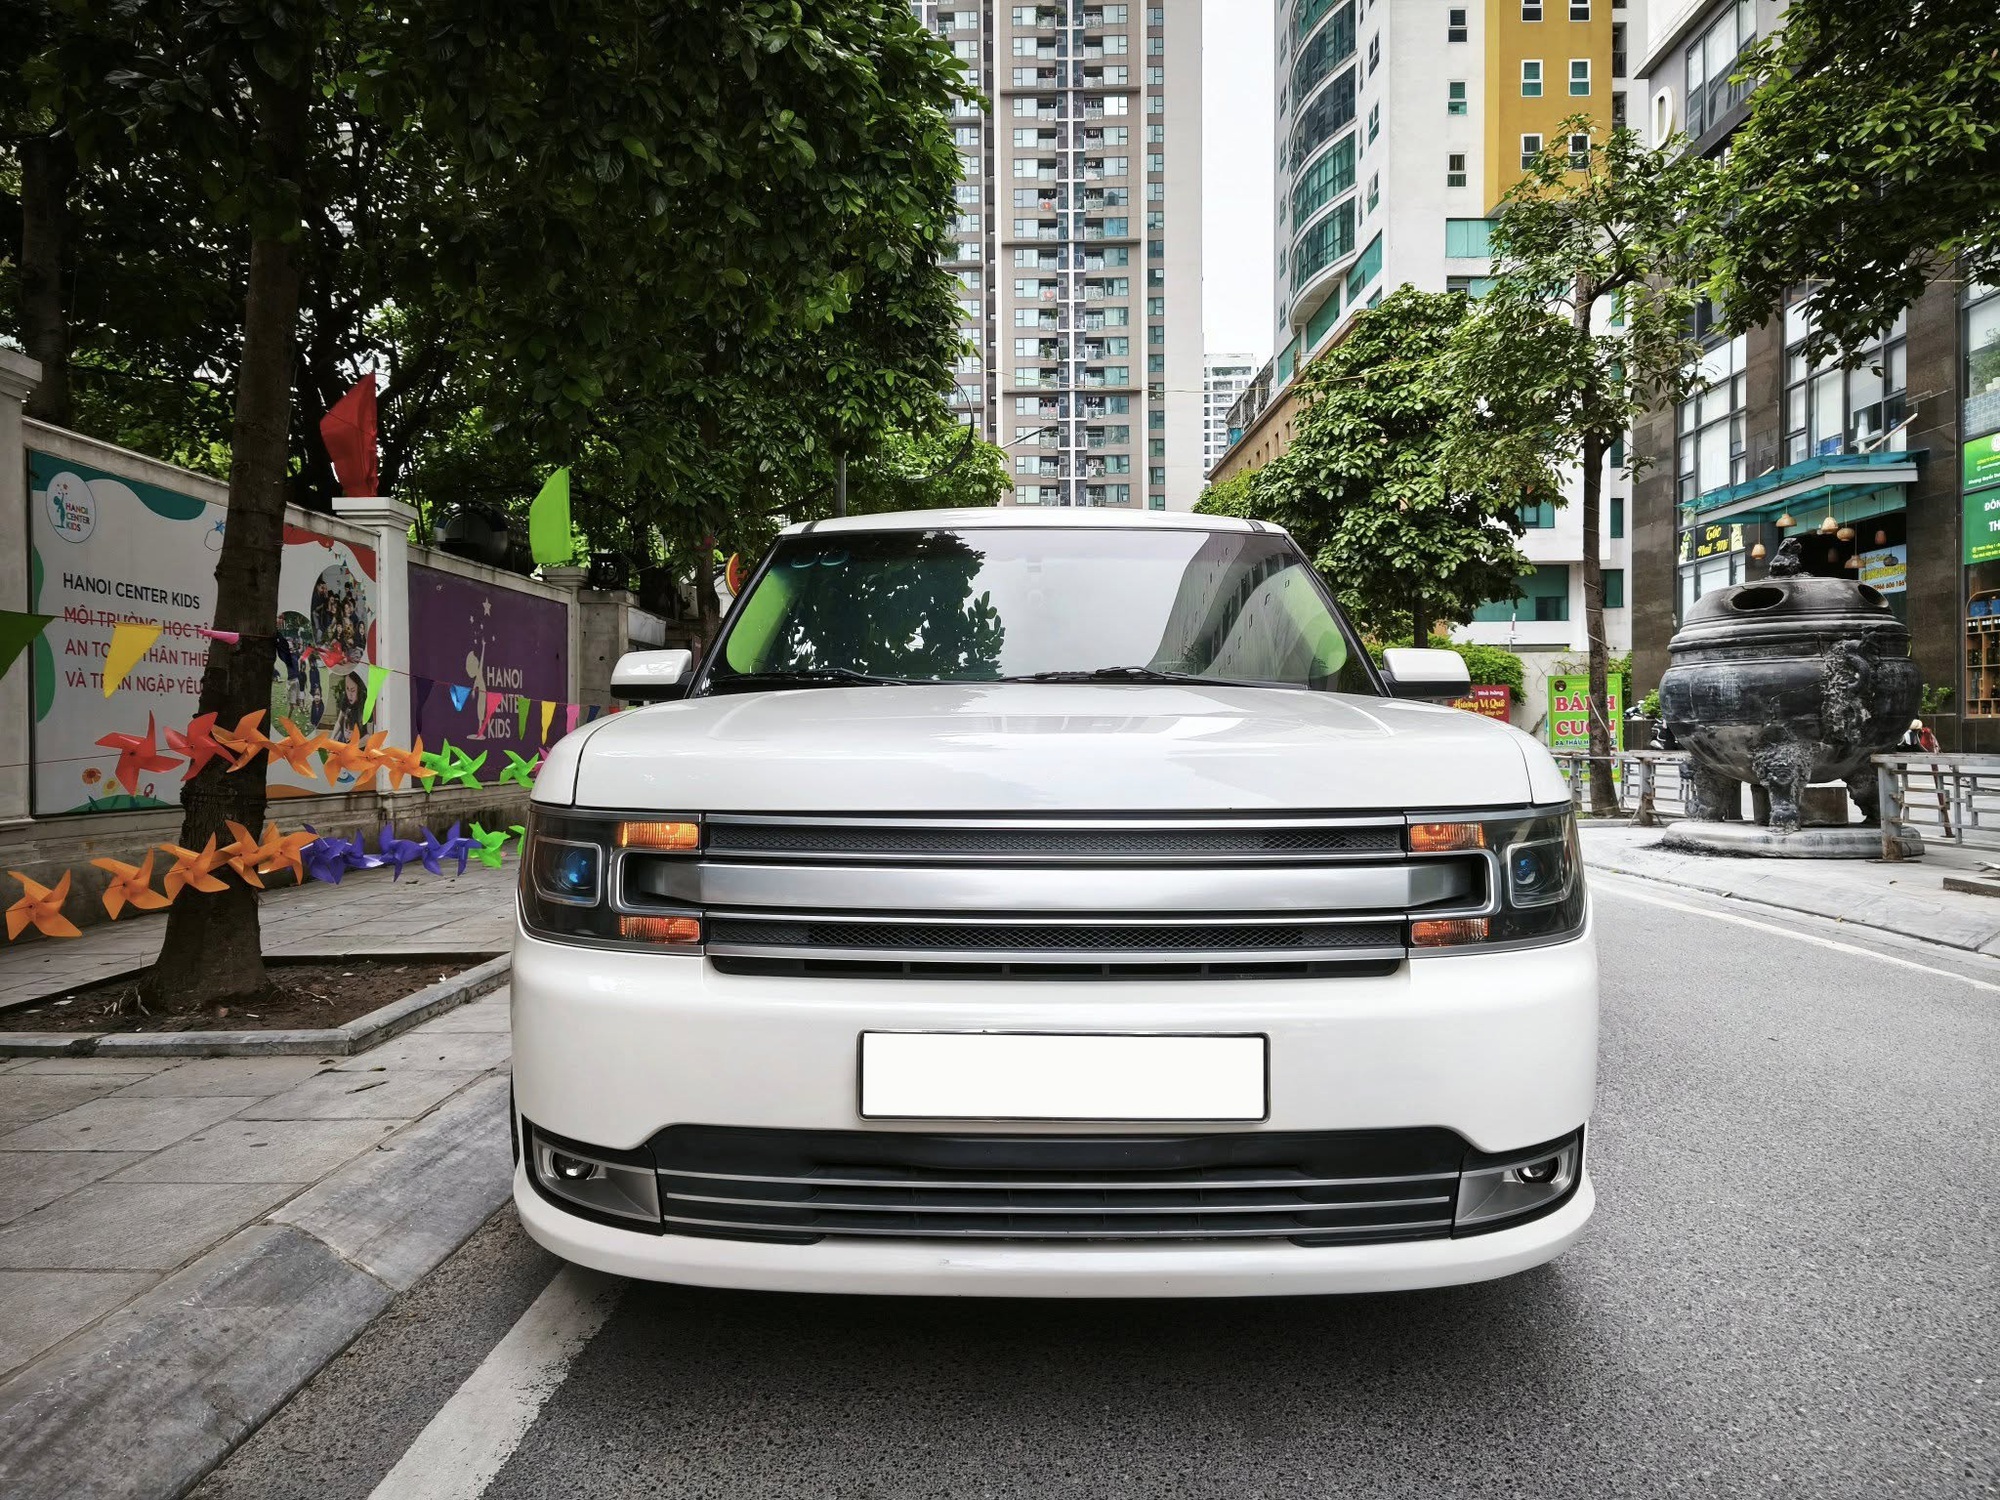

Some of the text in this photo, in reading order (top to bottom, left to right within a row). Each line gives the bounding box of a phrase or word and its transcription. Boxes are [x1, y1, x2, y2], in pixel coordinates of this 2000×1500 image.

[65, 502, 89, 514] HANOI
[66, 512, 90, 525] CENTER
[63, 572, 200, 609] HANOI CENTER KIDS
[64, 604, 94, 626] MÔI
[163, 619, 192, 640] HỌC
[65, 638, 88, 657] AN
[65, 667, 203, 697] VÀ TN NGẬP YÊU
[486, 666, 523, 689] HANOI
[487, 718, 511, 739] KIDS
[1556, 719, 1616, 737] CU
